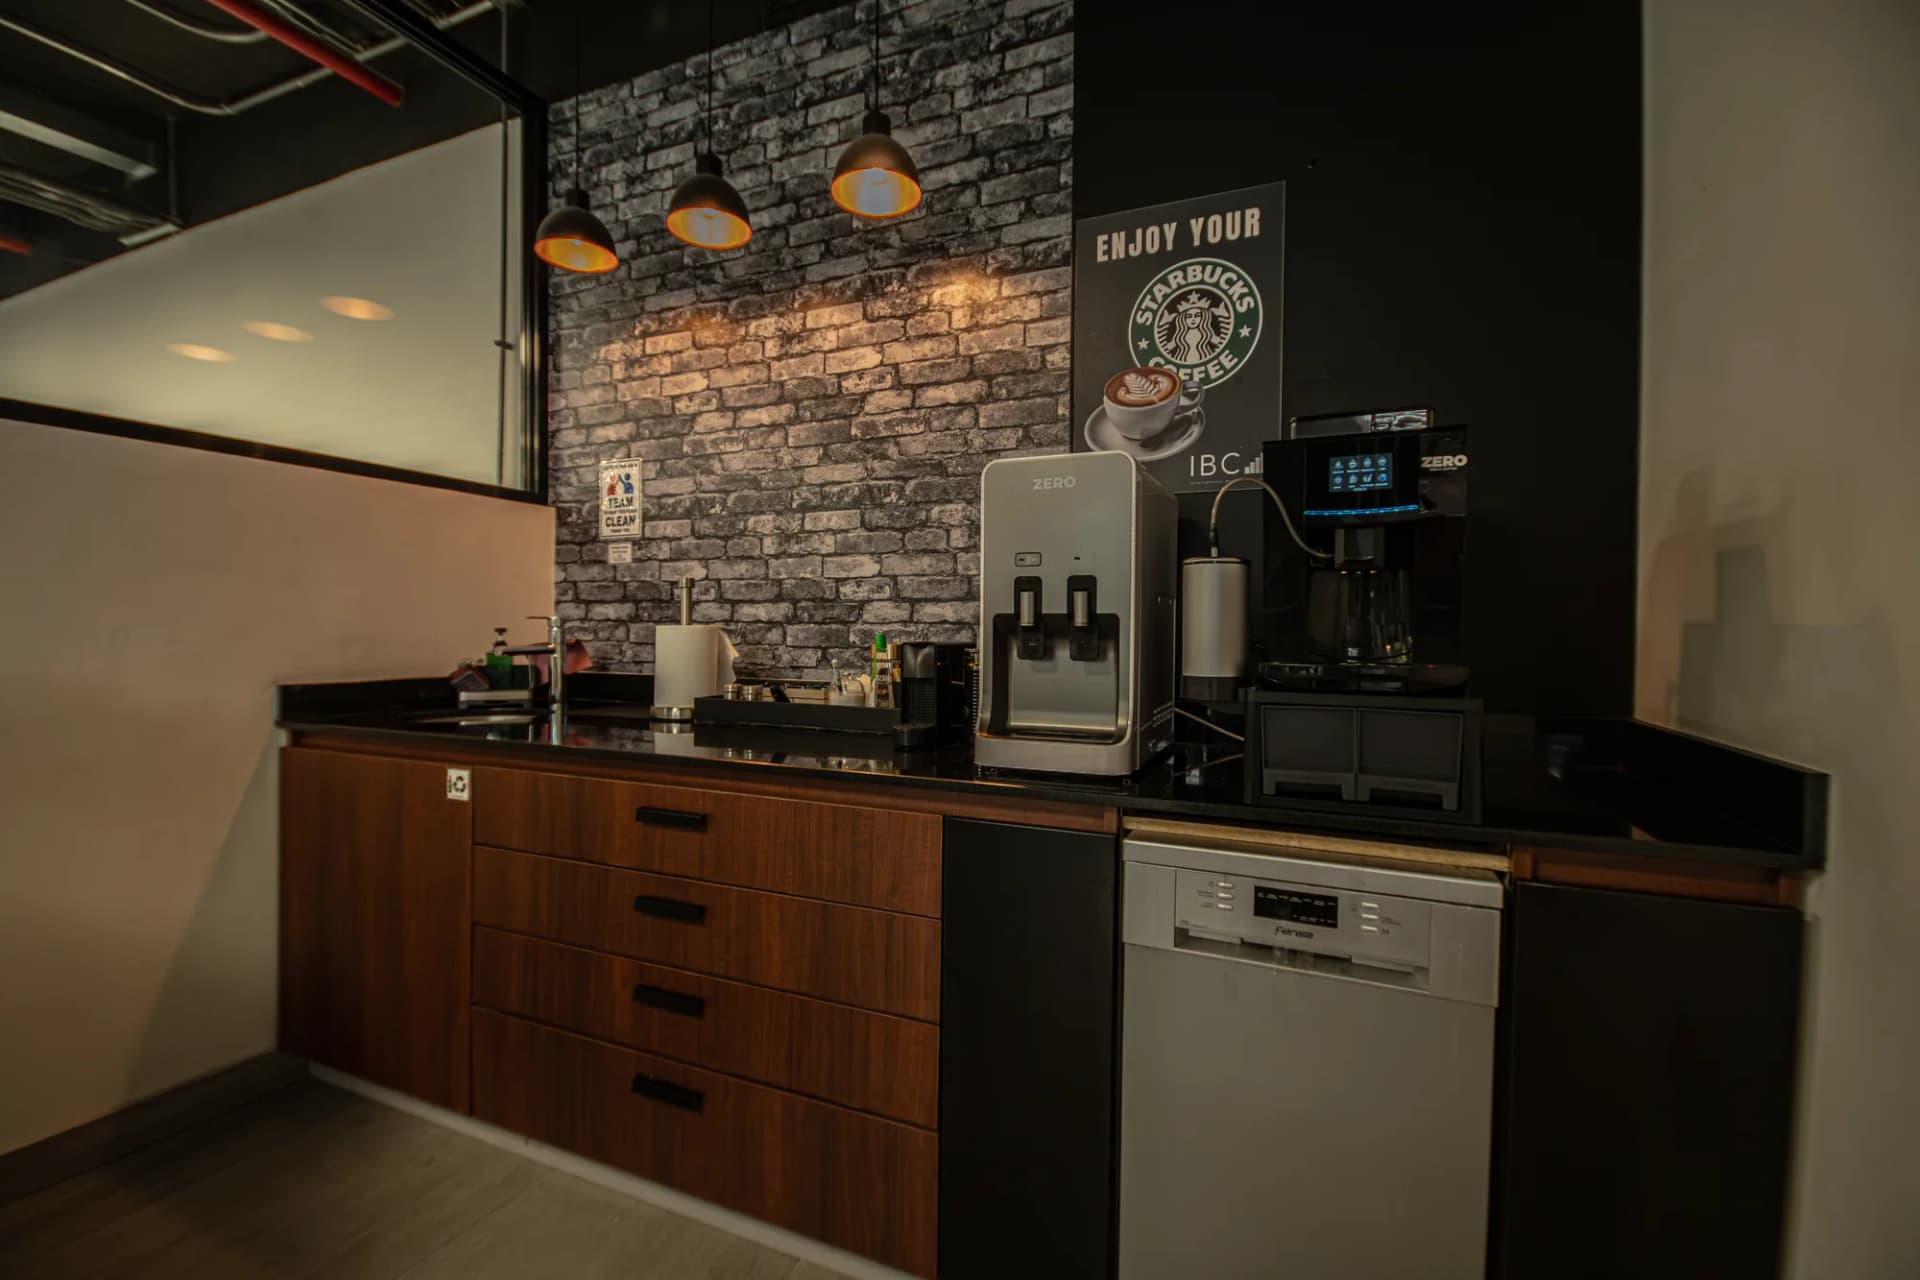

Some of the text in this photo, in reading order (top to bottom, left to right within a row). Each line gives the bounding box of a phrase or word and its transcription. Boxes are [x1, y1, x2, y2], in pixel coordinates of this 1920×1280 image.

[1096, 206, 1262, 263] ENJOY YOUR
[1136, 264, 1255, 327] STARBUCKS
[1189, 452, 1240, 477] IBC
[1420, 454, 1468, 468] ZERO
[1032, 475, 1077, 490] ZERO
[608, 496, 634, 508] TEAM
[605, 514, 636, 528] CLEAN
